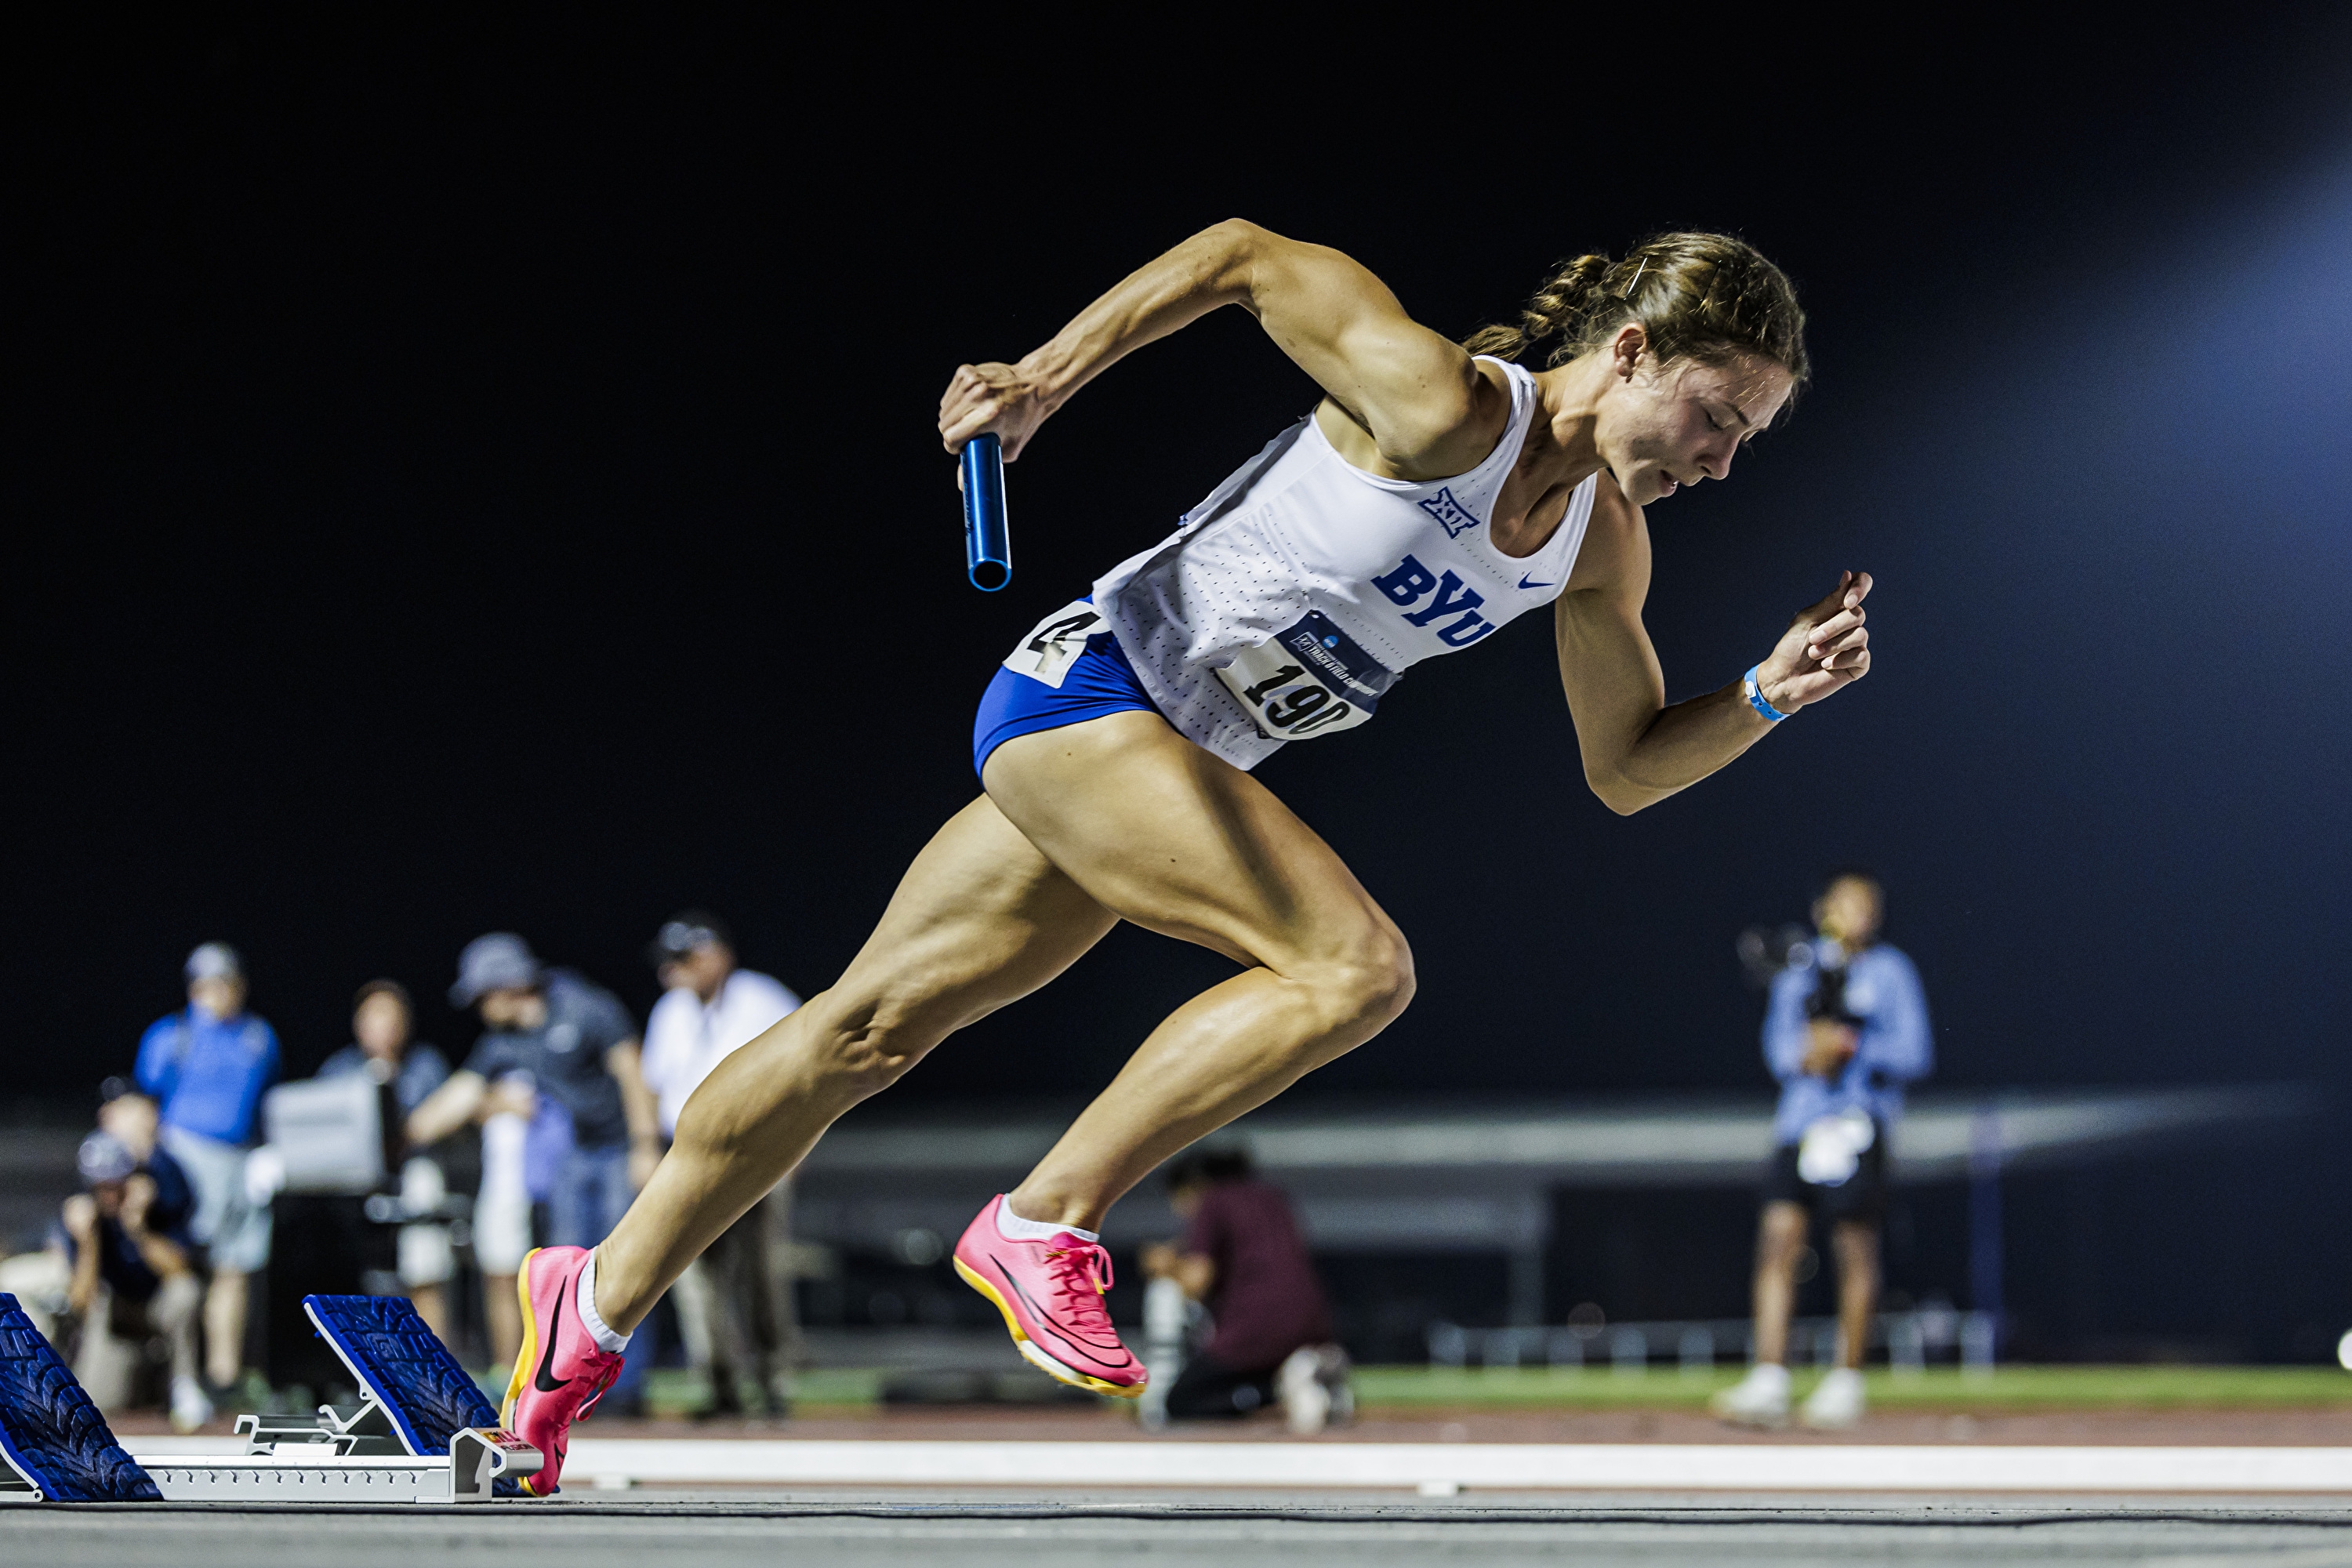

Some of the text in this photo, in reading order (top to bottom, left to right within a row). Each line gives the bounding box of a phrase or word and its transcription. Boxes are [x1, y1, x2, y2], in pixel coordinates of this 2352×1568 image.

[1370, 554, 1496, 648] BYU
[1308, 645, 1332, 665] TRACK
[1243, 665, 1350, 735] 190
